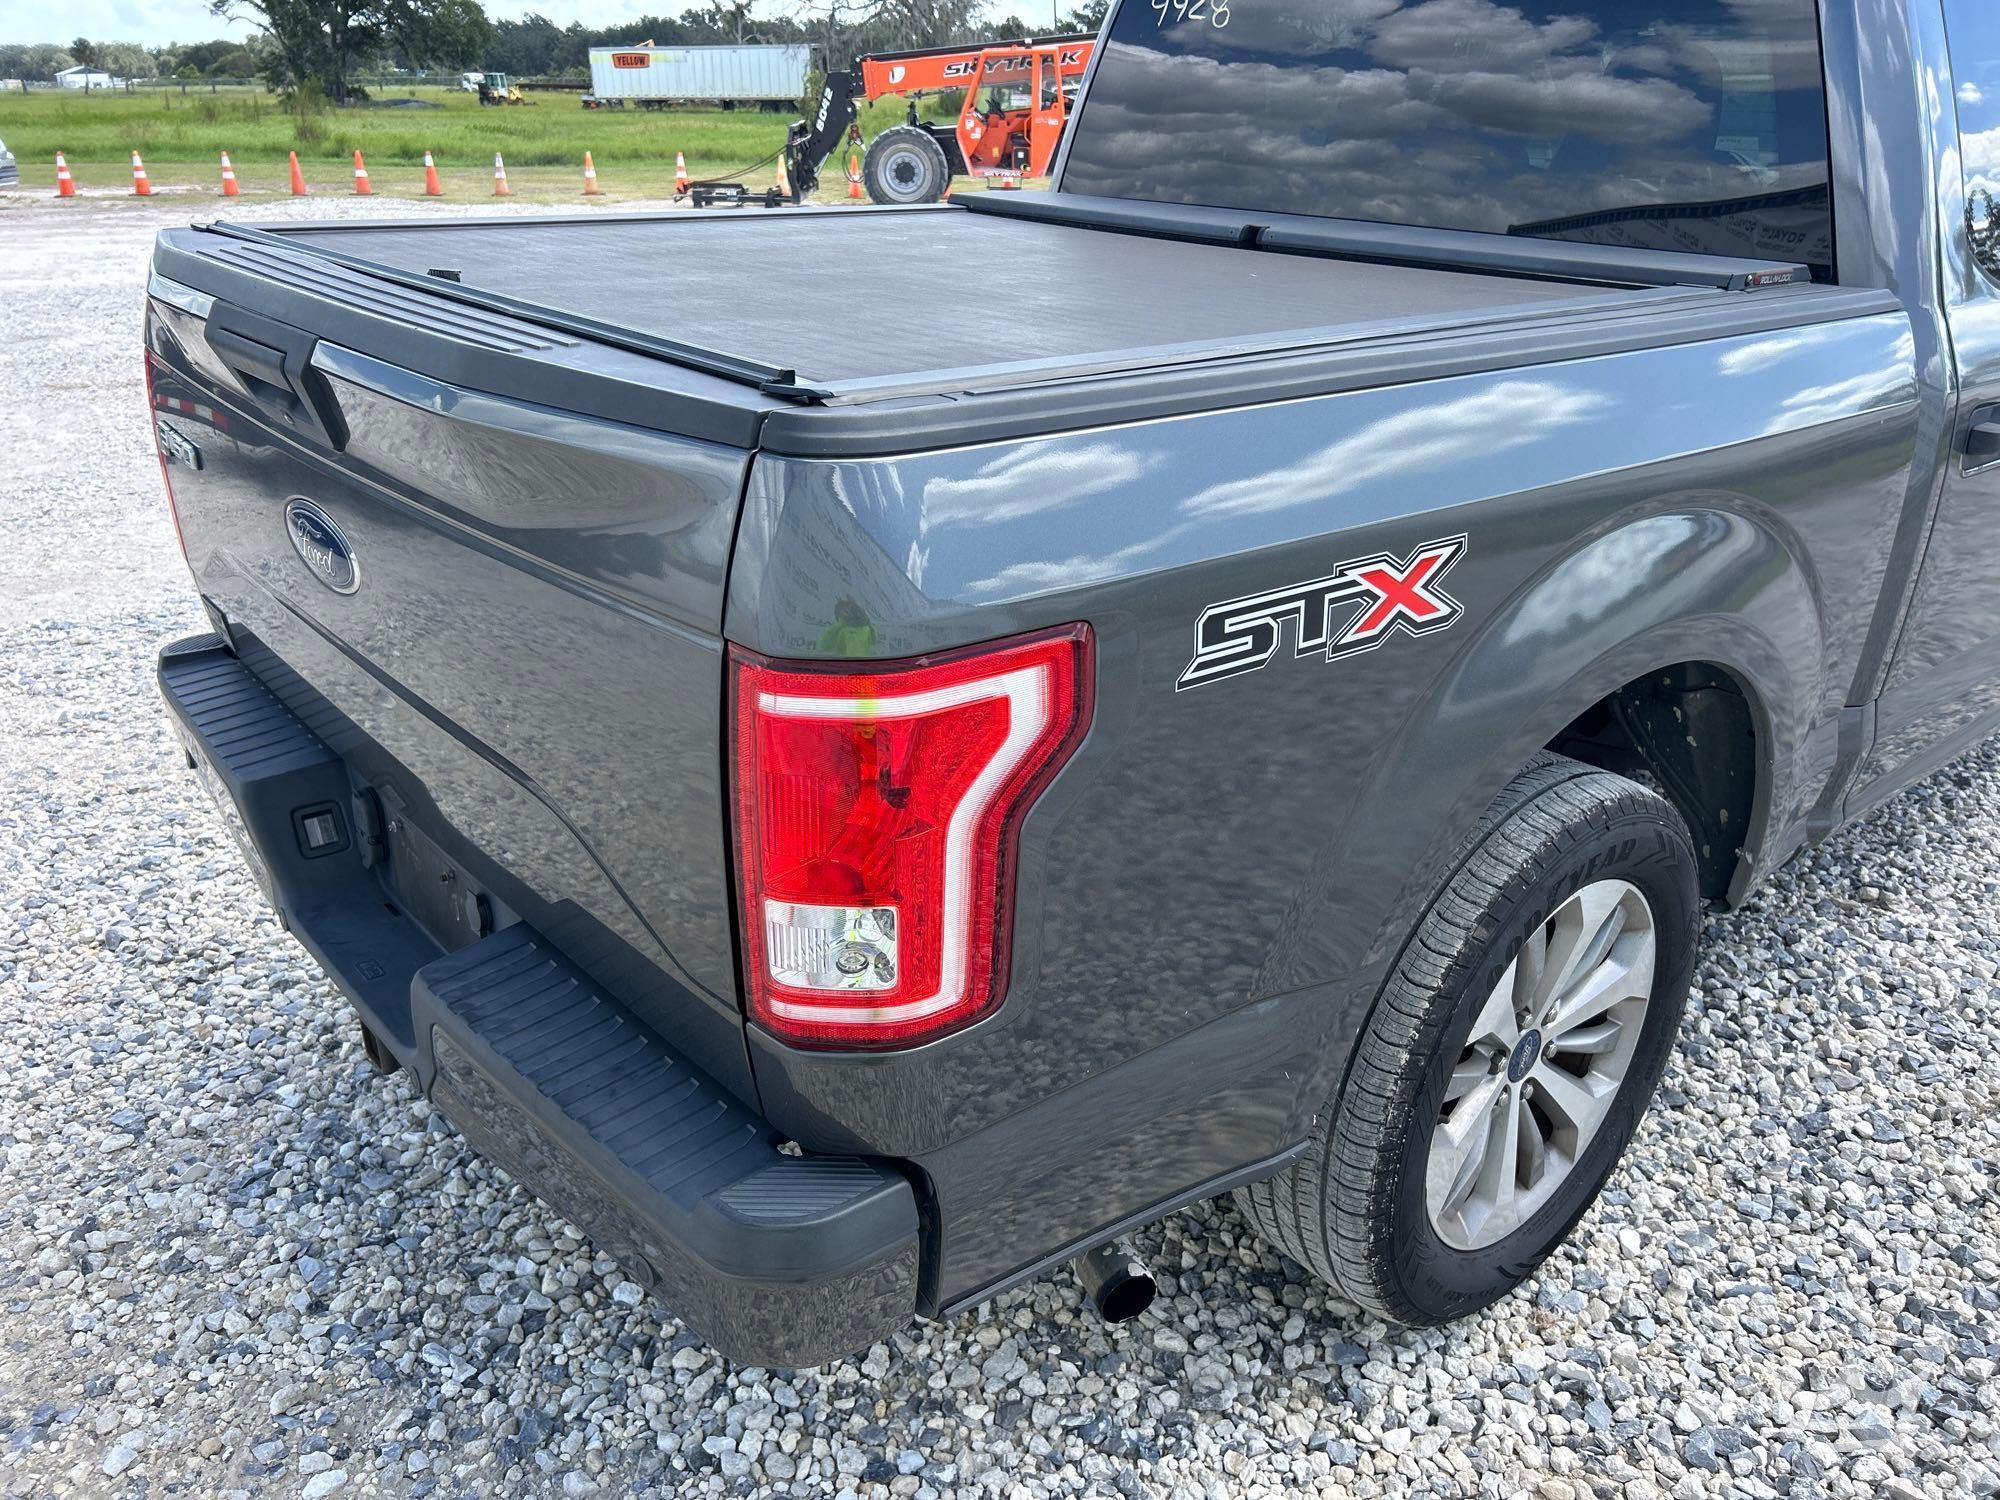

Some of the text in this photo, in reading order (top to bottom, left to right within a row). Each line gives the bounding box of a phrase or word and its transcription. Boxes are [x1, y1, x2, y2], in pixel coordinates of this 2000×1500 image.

[1151, 0, 1230, 28] 9928
[616, 55, 646, 66] YELLOW
[815, 87, 833, 132] 8042
[296, 517, 337, 577] Ford
[1176, 533, 1467, 692] STX
[1517, 1036, 1533, 1077] Ford
